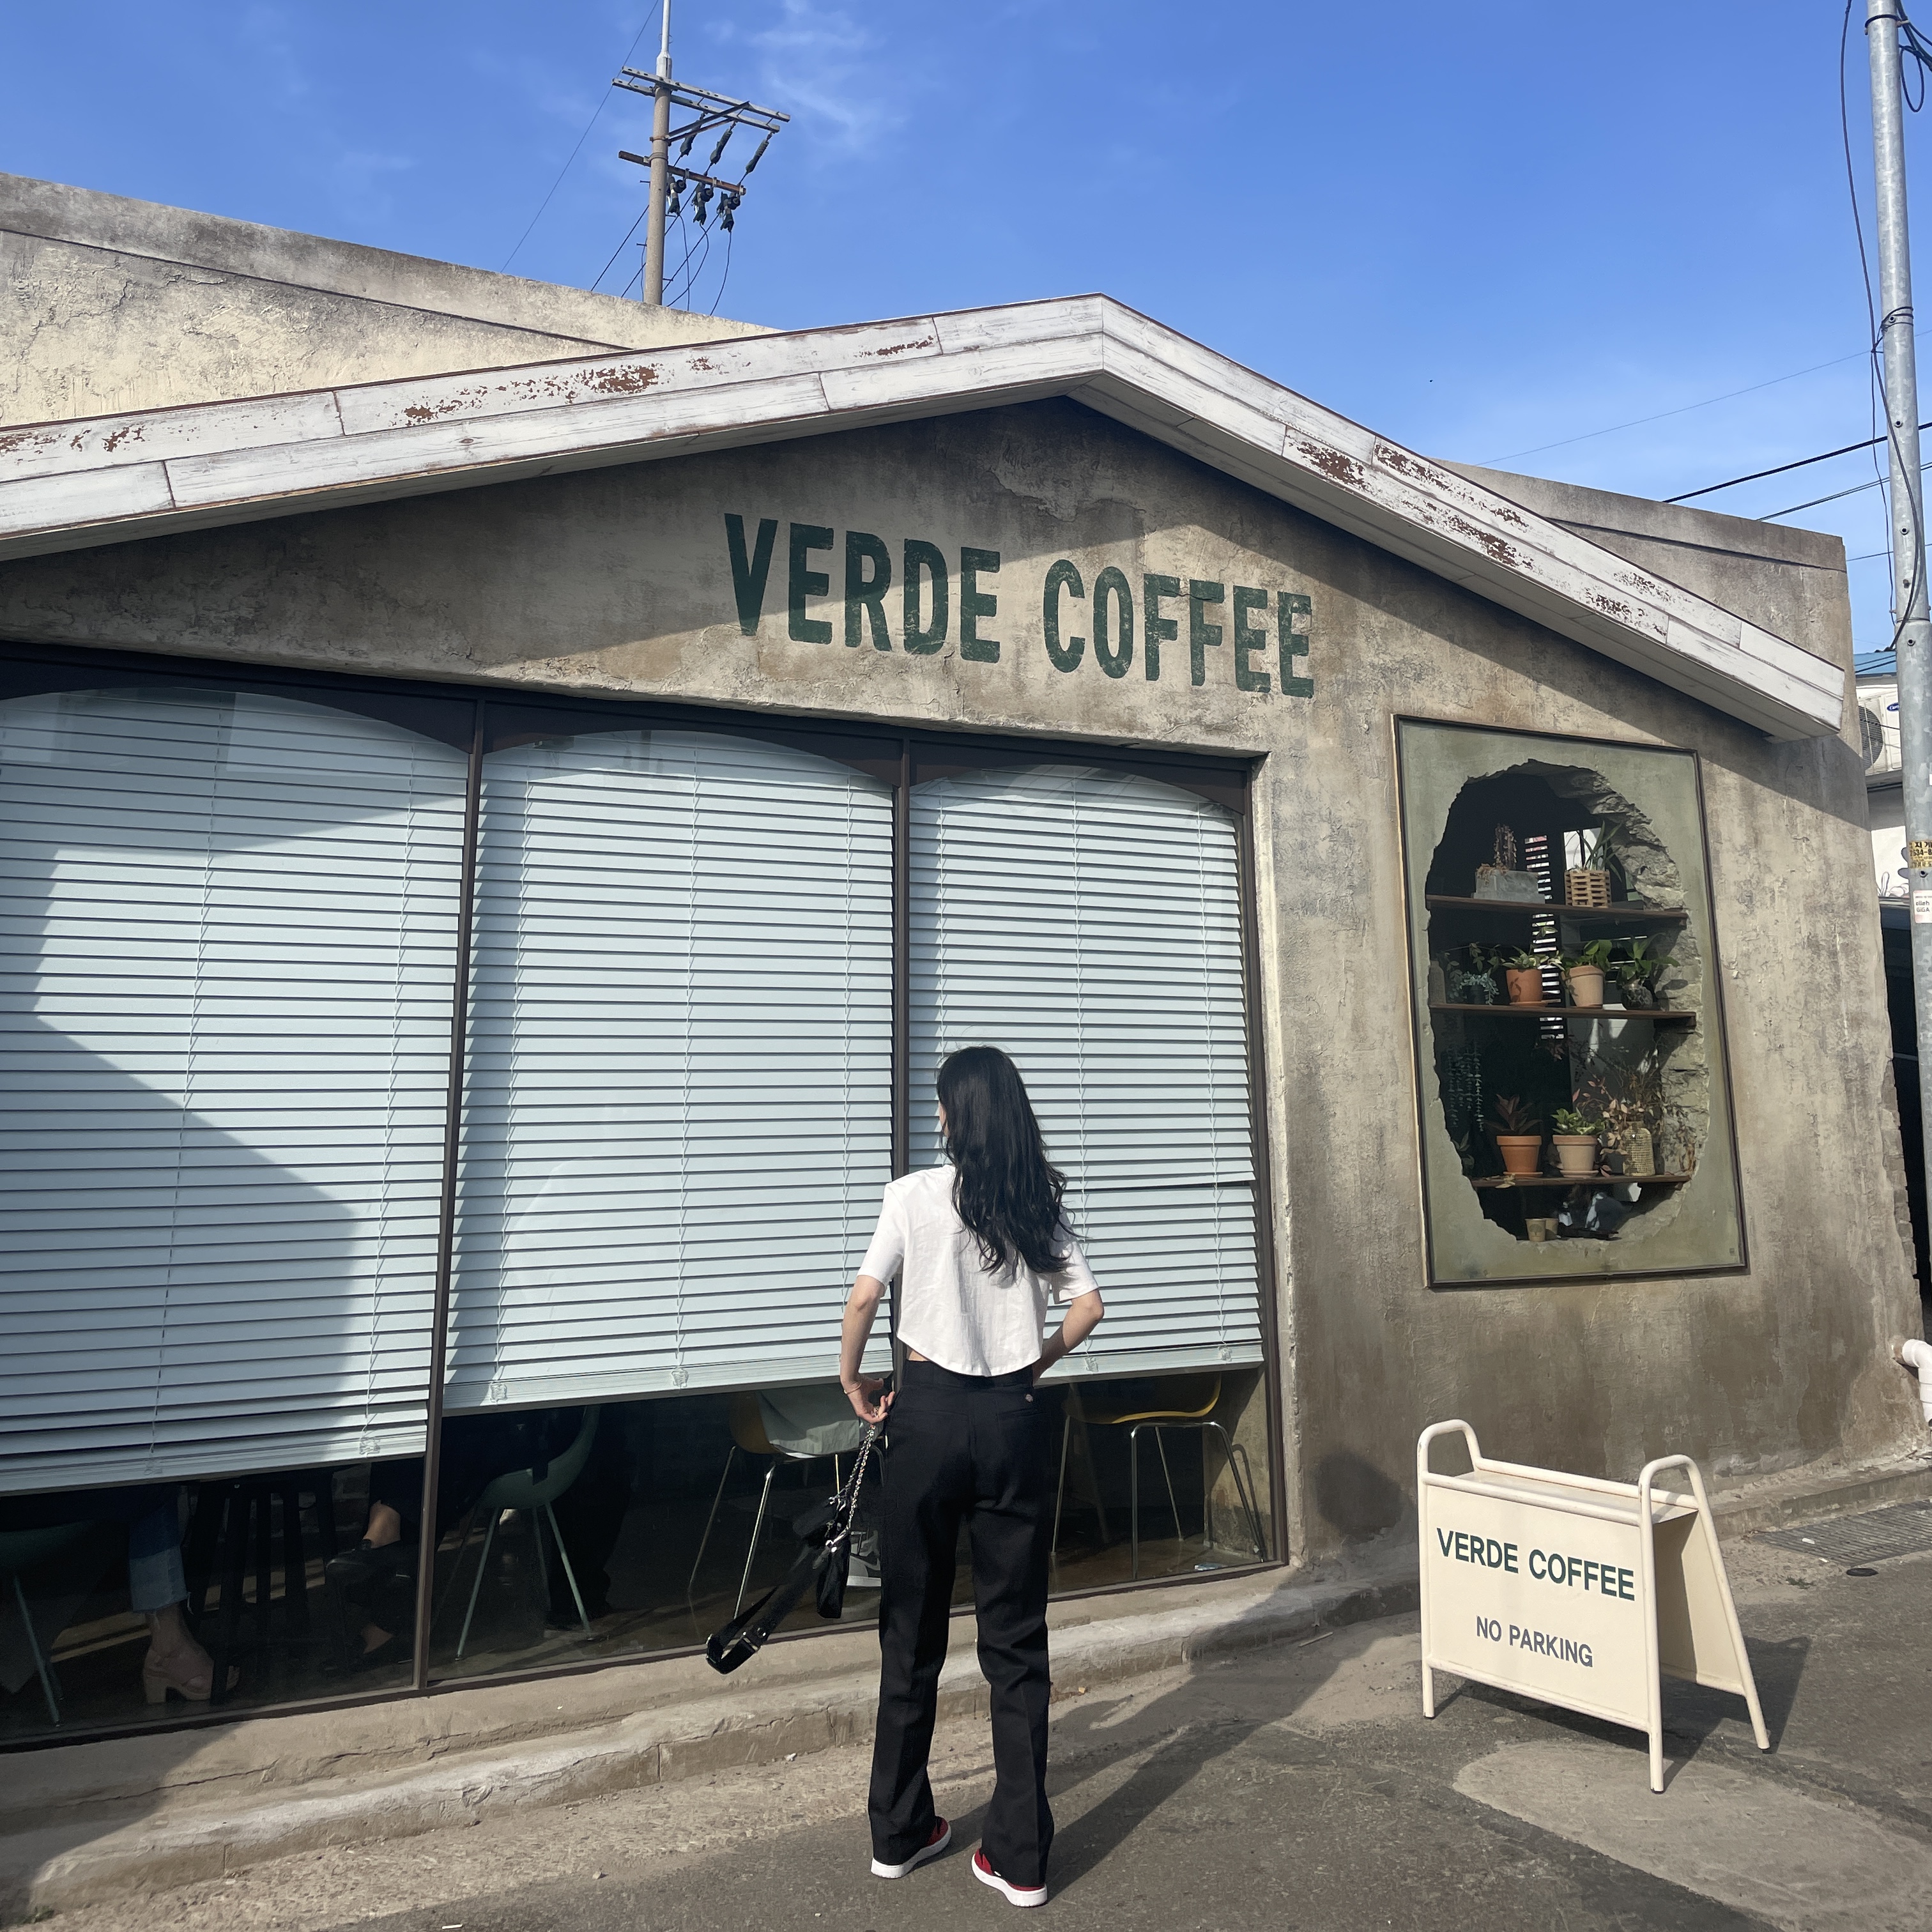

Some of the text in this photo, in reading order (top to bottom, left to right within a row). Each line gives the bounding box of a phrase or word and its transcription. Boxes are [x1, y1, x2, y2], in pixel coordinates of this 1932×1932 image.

[724, 513, 1314, 699] VERDE COFFEE
[1436, 1527, 1635, 1601] VERDE COFFEE
[1476, 1615, 1593, 1667] NO PARKING
